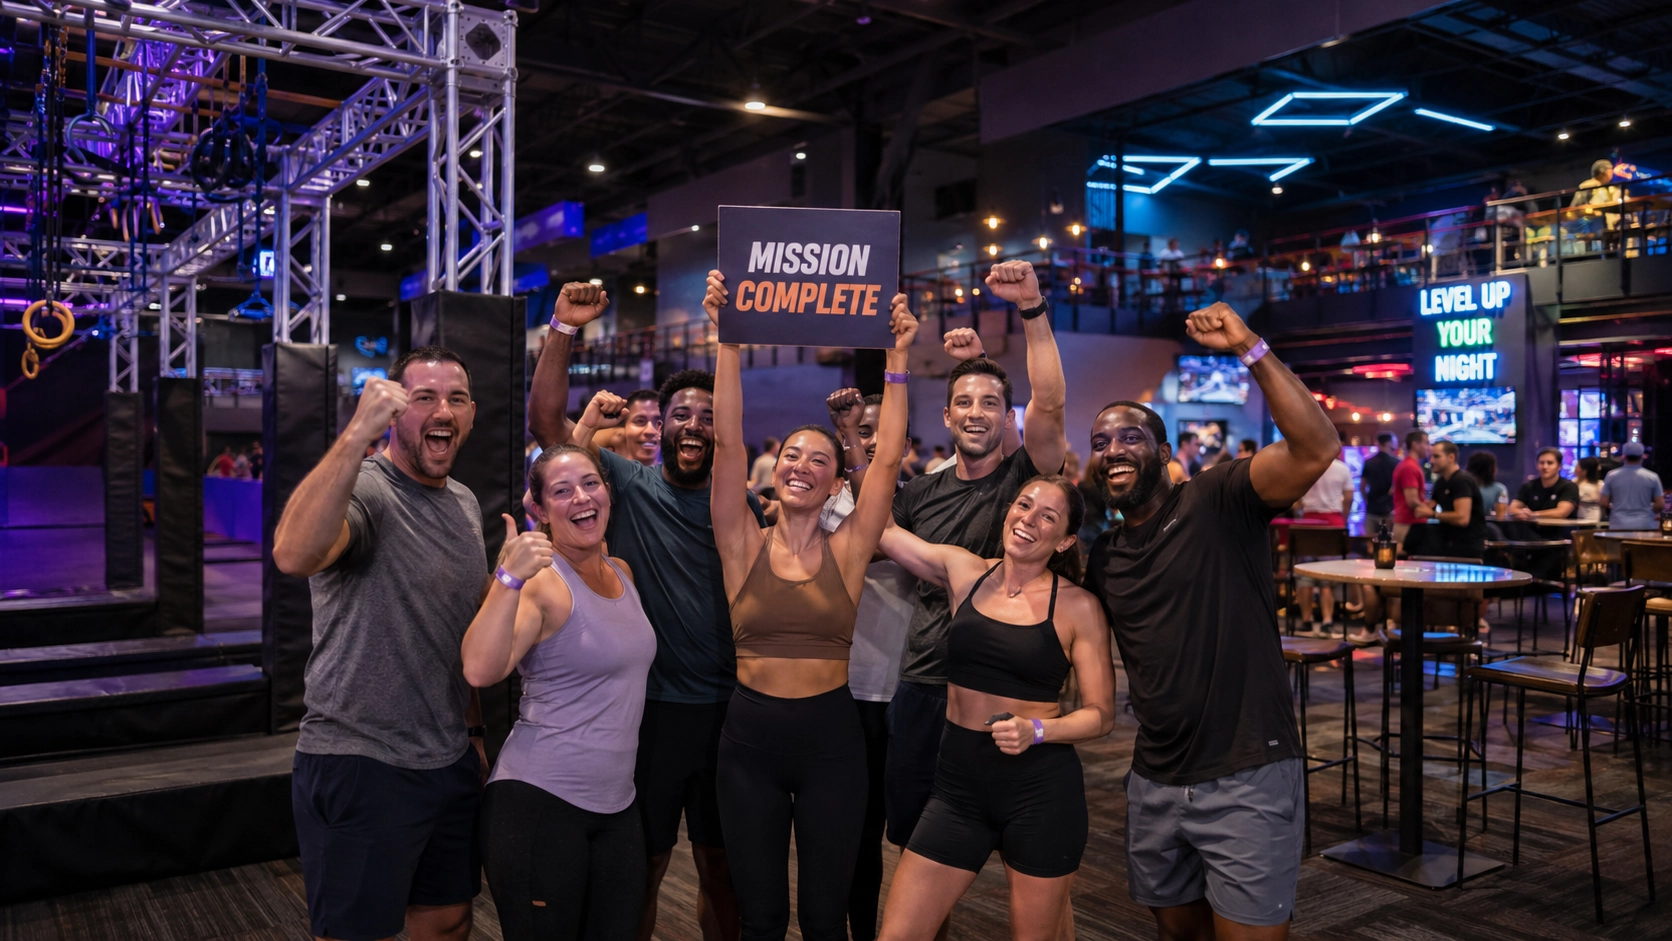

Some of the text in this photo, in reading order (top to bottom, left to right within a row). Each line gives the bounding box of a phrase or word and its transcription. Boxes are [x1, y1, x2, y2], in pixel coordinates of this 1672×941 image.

[748, 241, 871, 277] MISSION
[735, 280, 882, 316] COMPLETE
[1420, 281, 1511, 316] LEVEL UP
[1437, 318, 1492, 347] YOUR
[1435, 353, 1497, 382] NIGHT
